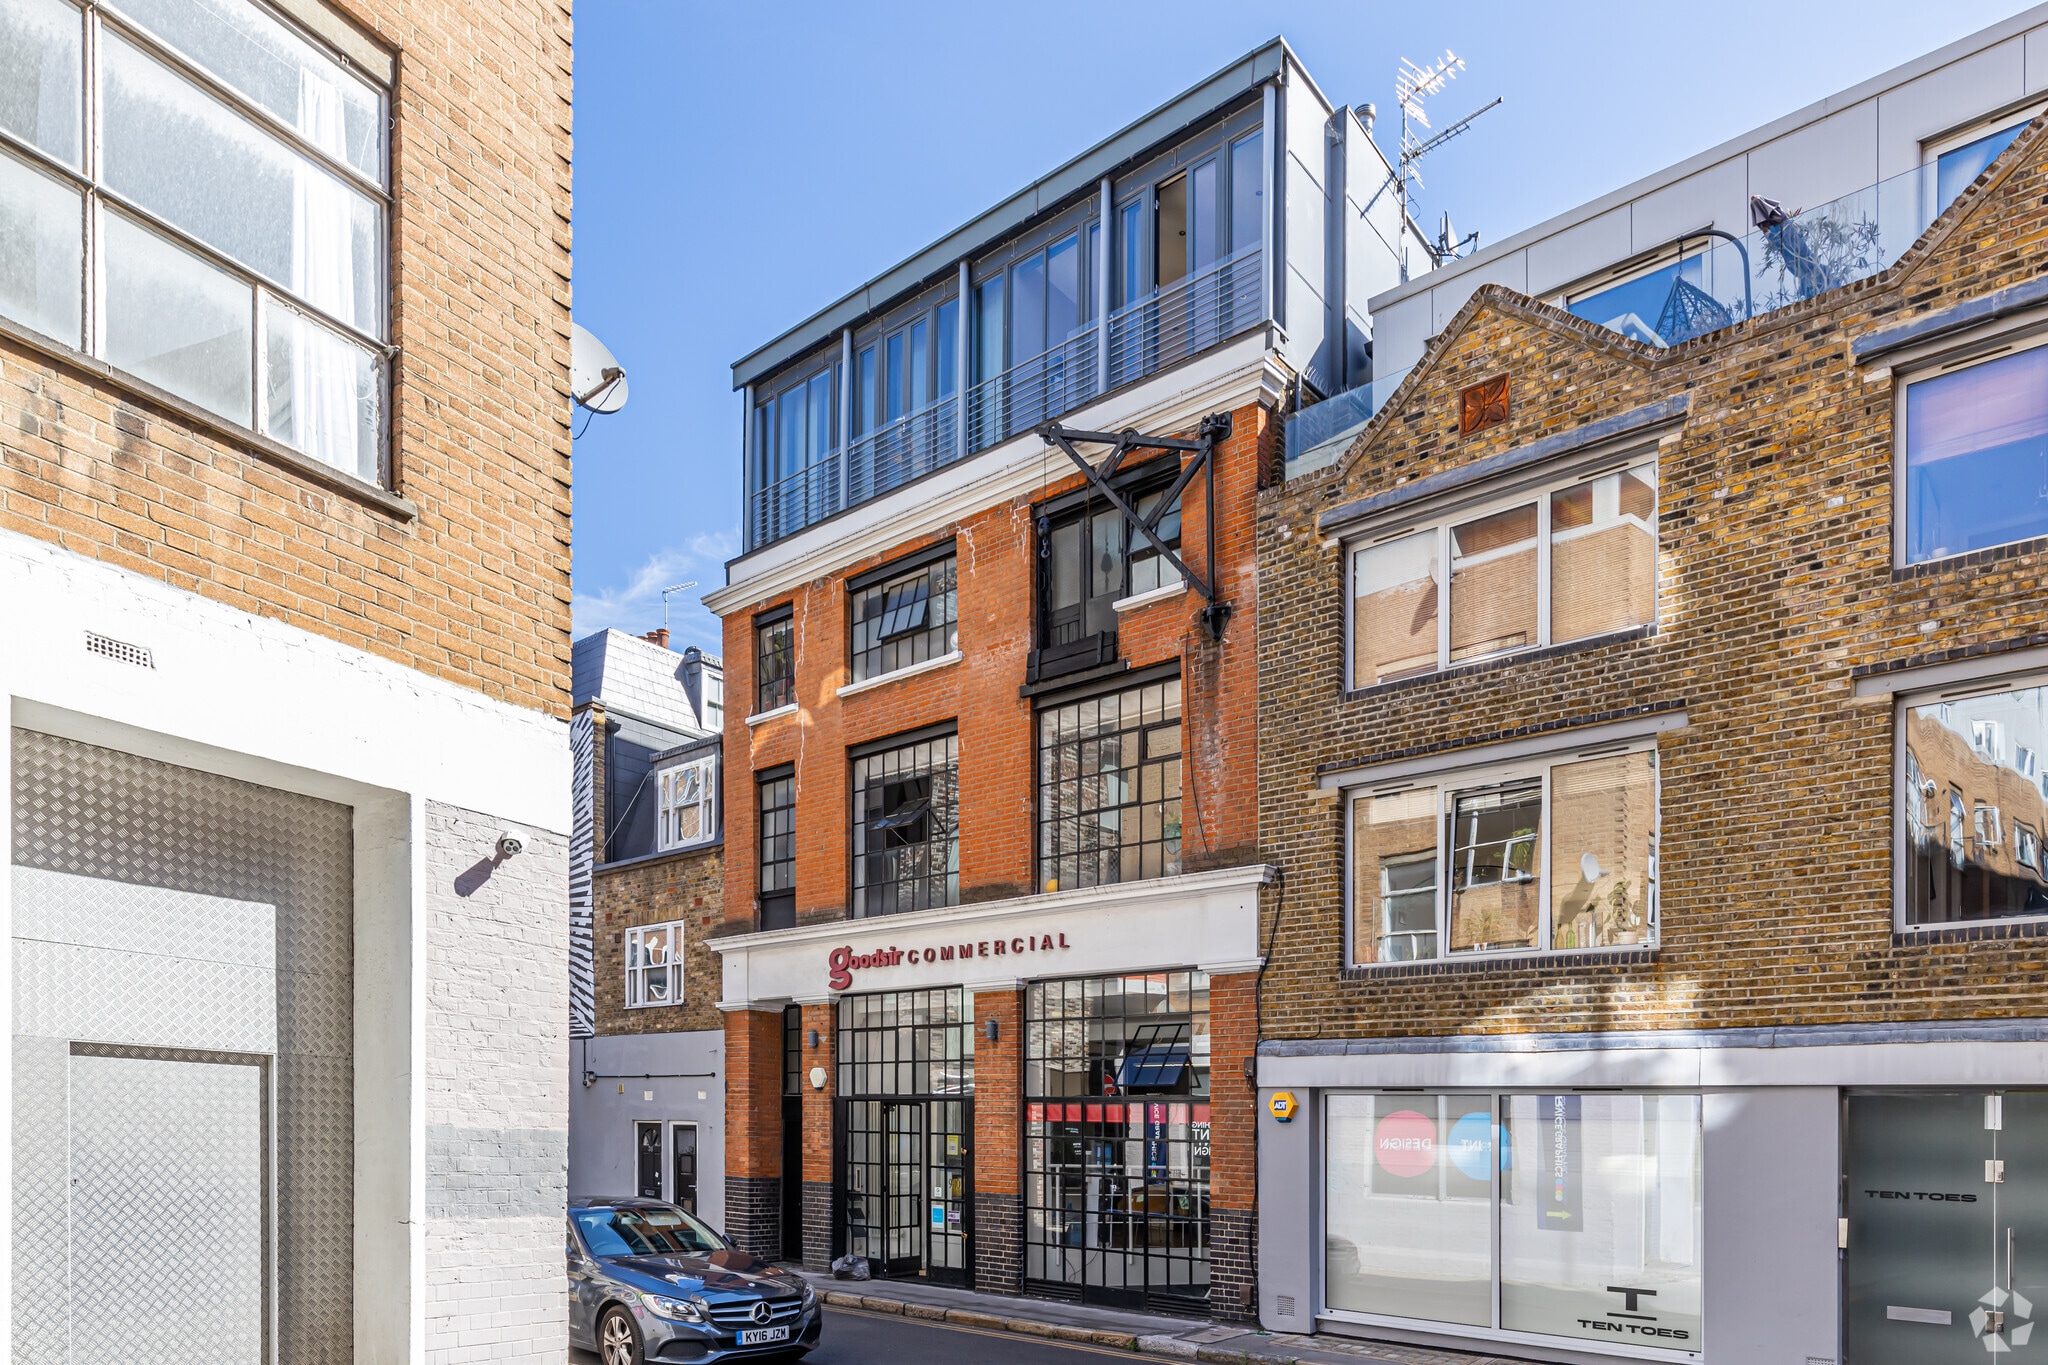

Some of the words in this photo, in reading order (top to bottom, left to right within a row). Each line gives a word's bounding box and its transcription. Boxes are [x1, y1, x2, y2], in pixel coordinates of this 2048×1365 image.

[828, 945, 904, 990] goodsir
[907, 932, 1071, 964] COMMERCIAL
[1274, 1101, 1286, 1110] ADT
[1864, 1190, 1910, 1199] TEN
[1913, 1192, 1977, 1202] TOES
[1577, 1319, 1622, 1332] TEN
[1626, 1324, 1689, 1340] TOES
[745, 1331, 768, 1343] KY16
